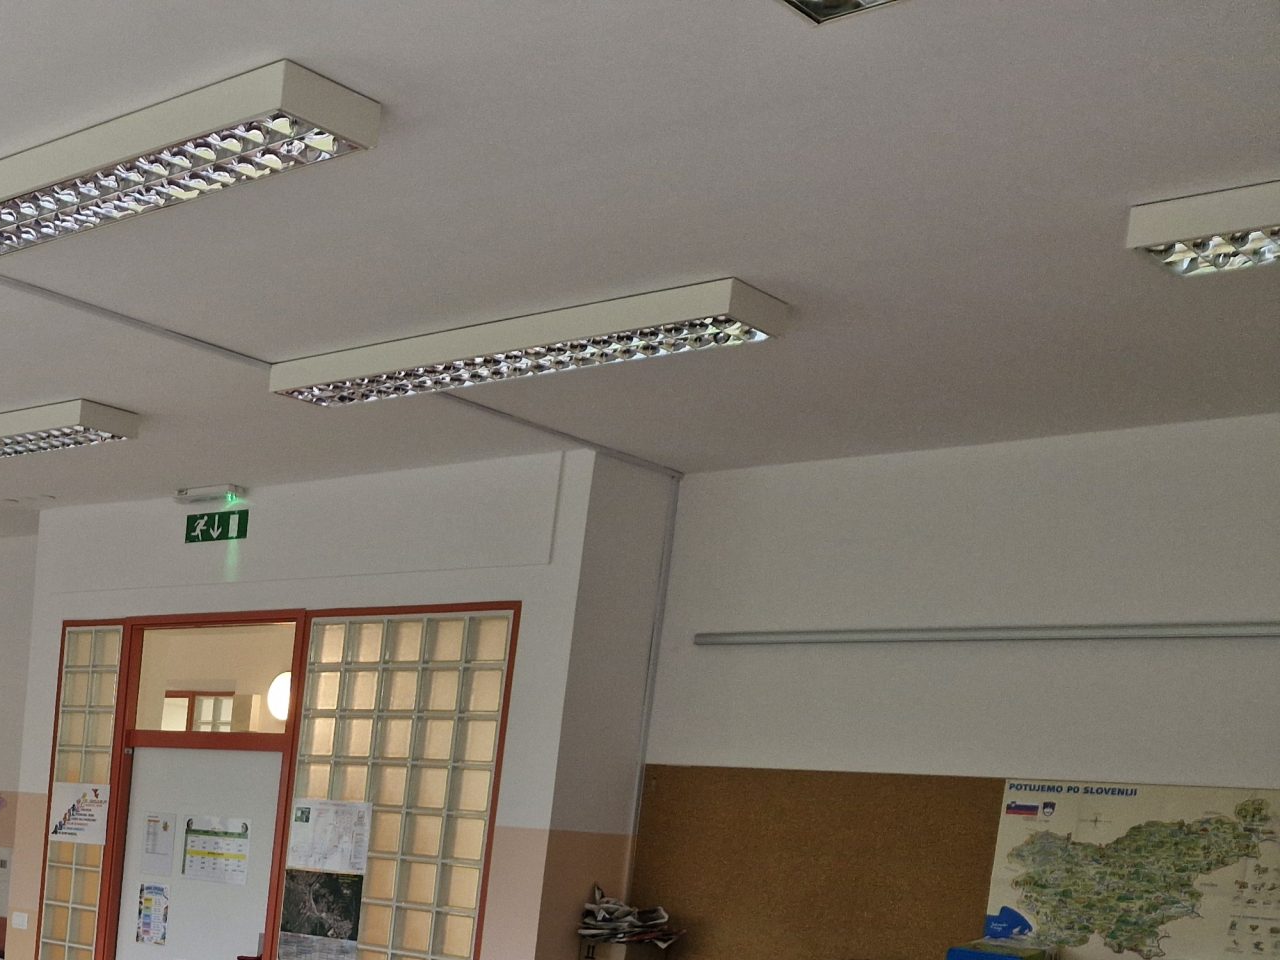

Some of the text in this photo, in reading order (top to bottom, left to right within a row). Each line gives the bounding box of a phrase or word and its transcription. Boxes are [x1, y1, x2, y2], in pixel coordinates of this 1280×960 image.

[1008, 782, 1138, 797] POTUJEMO PO SLOVENIJI
